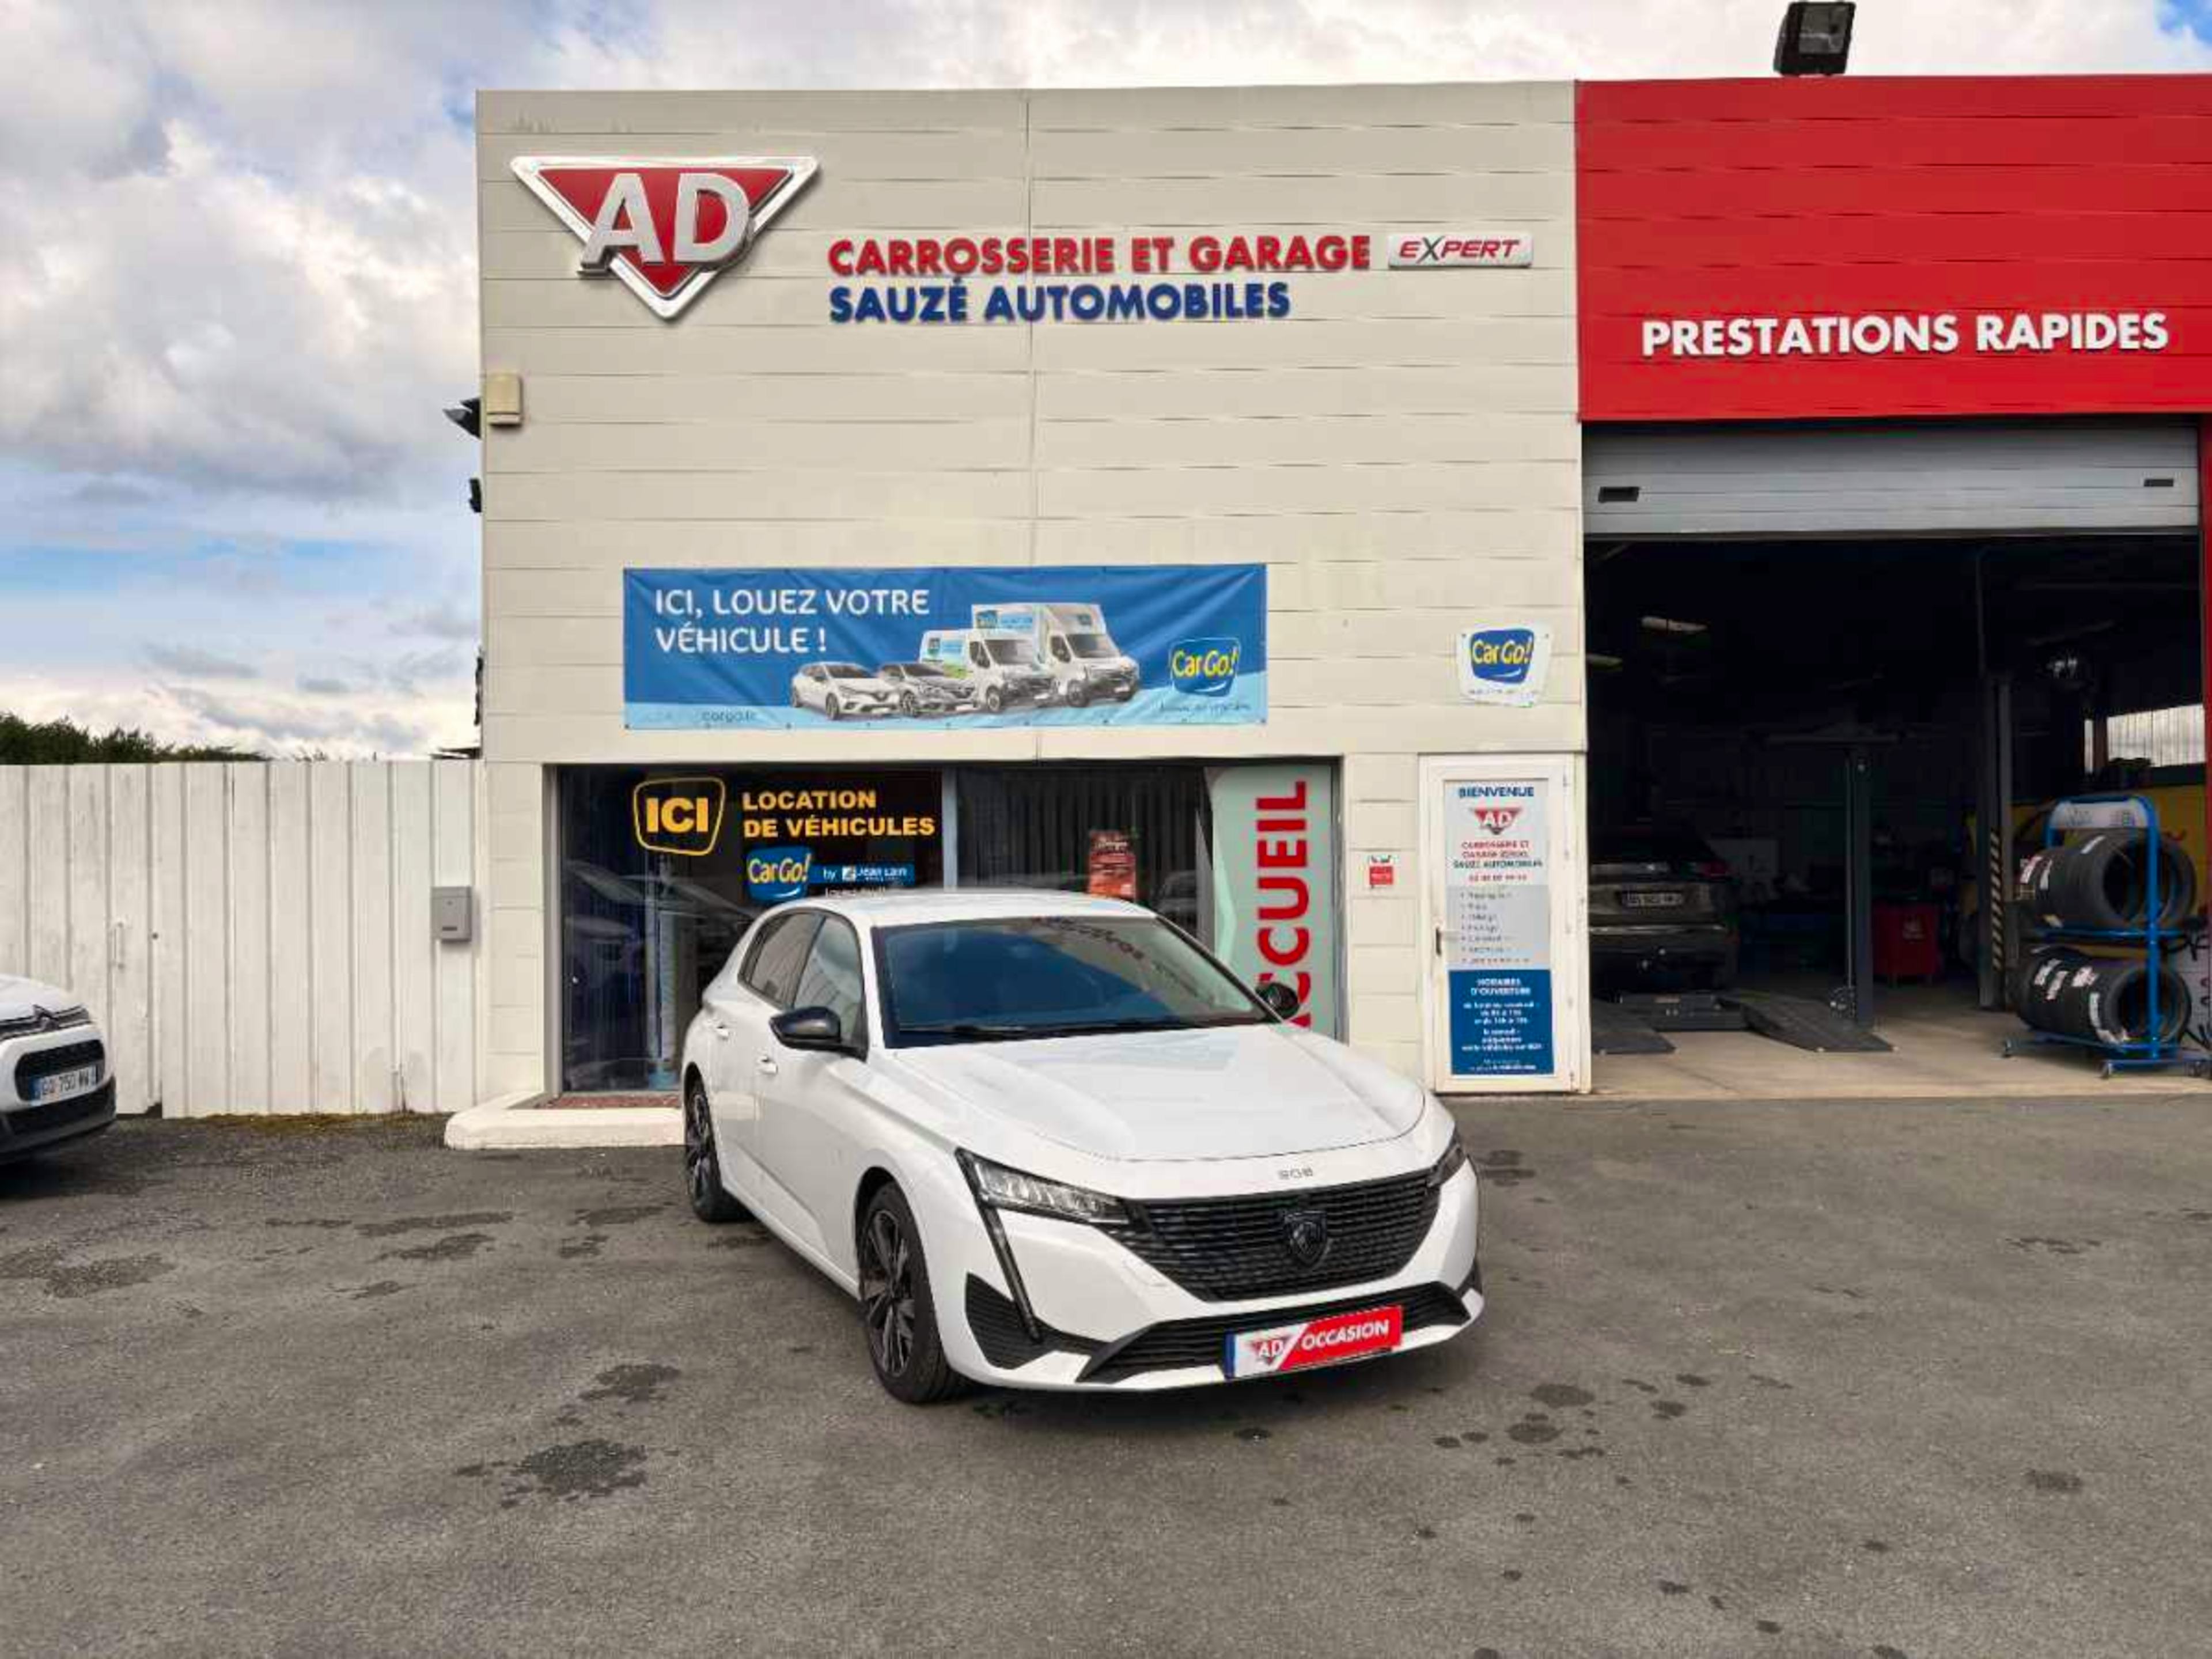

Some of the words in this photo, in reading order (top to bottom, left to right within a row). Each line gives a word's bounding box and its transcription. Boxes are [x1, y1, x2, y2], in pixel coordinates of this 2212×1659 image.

[579, 172, 751, 273] AD
[828, 237, 1114, 275] CARROSSERIE
[1131, 237, 1175, 273] ET
[1189, 235, 1370, 271] GARAGE
[1399, 237, 1521, 263] EXPERT
[830, 277, 969, 323] SAUZÉ
[984, 282, 1291, 322] AUTOMOBILES
[1642, 314, 1958, 356] PRESTATIONS
[1975, 312, 2169, 353] RAPIDES
[655, 589, 703, 618] ICI,
[713, 589, 817, 616] LOUEZ
[825, 588, 930, 616] VOTRE
[655, 622, 809, 653] VÉHICULE
[818, 628, 827, 652] !
[742, 790, 877, 812] LOCATION
[1459, 786, 1535, 798] BIENVENUE
[646, 796, 709, 834] ICI
[744, 819, 779, 838] DE
[786, 814, 935, 838] VÉHICULES
[1483, 811, 1512, 827] AD
[823, 866, 837, 880] by
[1256, 780, 1312, 1029] CUEIL
[1258, 1339, 1284, 1357] AD
[1301, 1319, 1390, 1350] OCCASION
